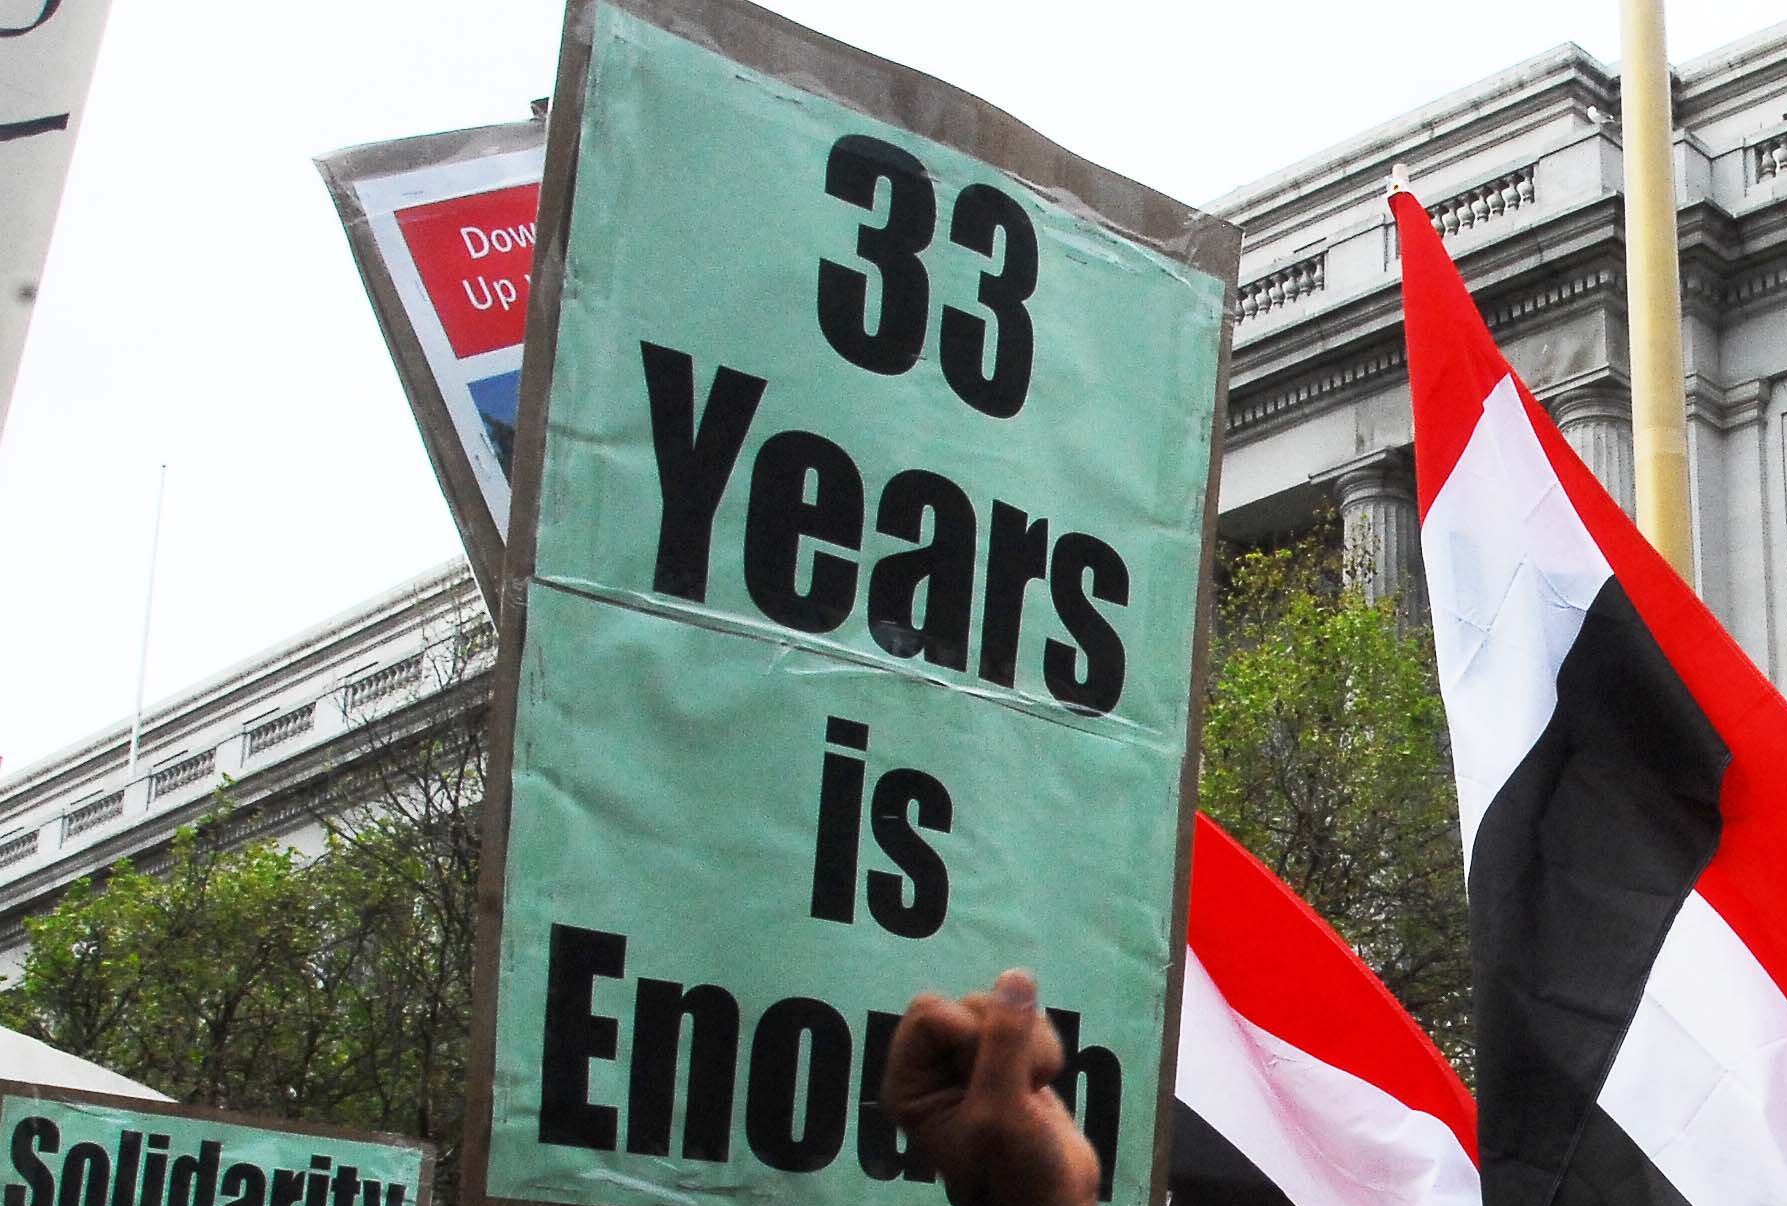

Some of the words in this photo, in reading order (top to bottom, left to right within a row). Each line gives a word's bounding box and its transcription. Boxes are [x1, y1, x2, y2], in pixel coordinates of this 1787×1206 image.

[460, 222, 537, 259] Dow
[462, 276, 517, 311] Up
[816, 133, 1040, 420] 33
[639, 340, 1130, 717] Years
[810, 714, 954, 939] is
[538, 922, 1122, 1203] Enouh
